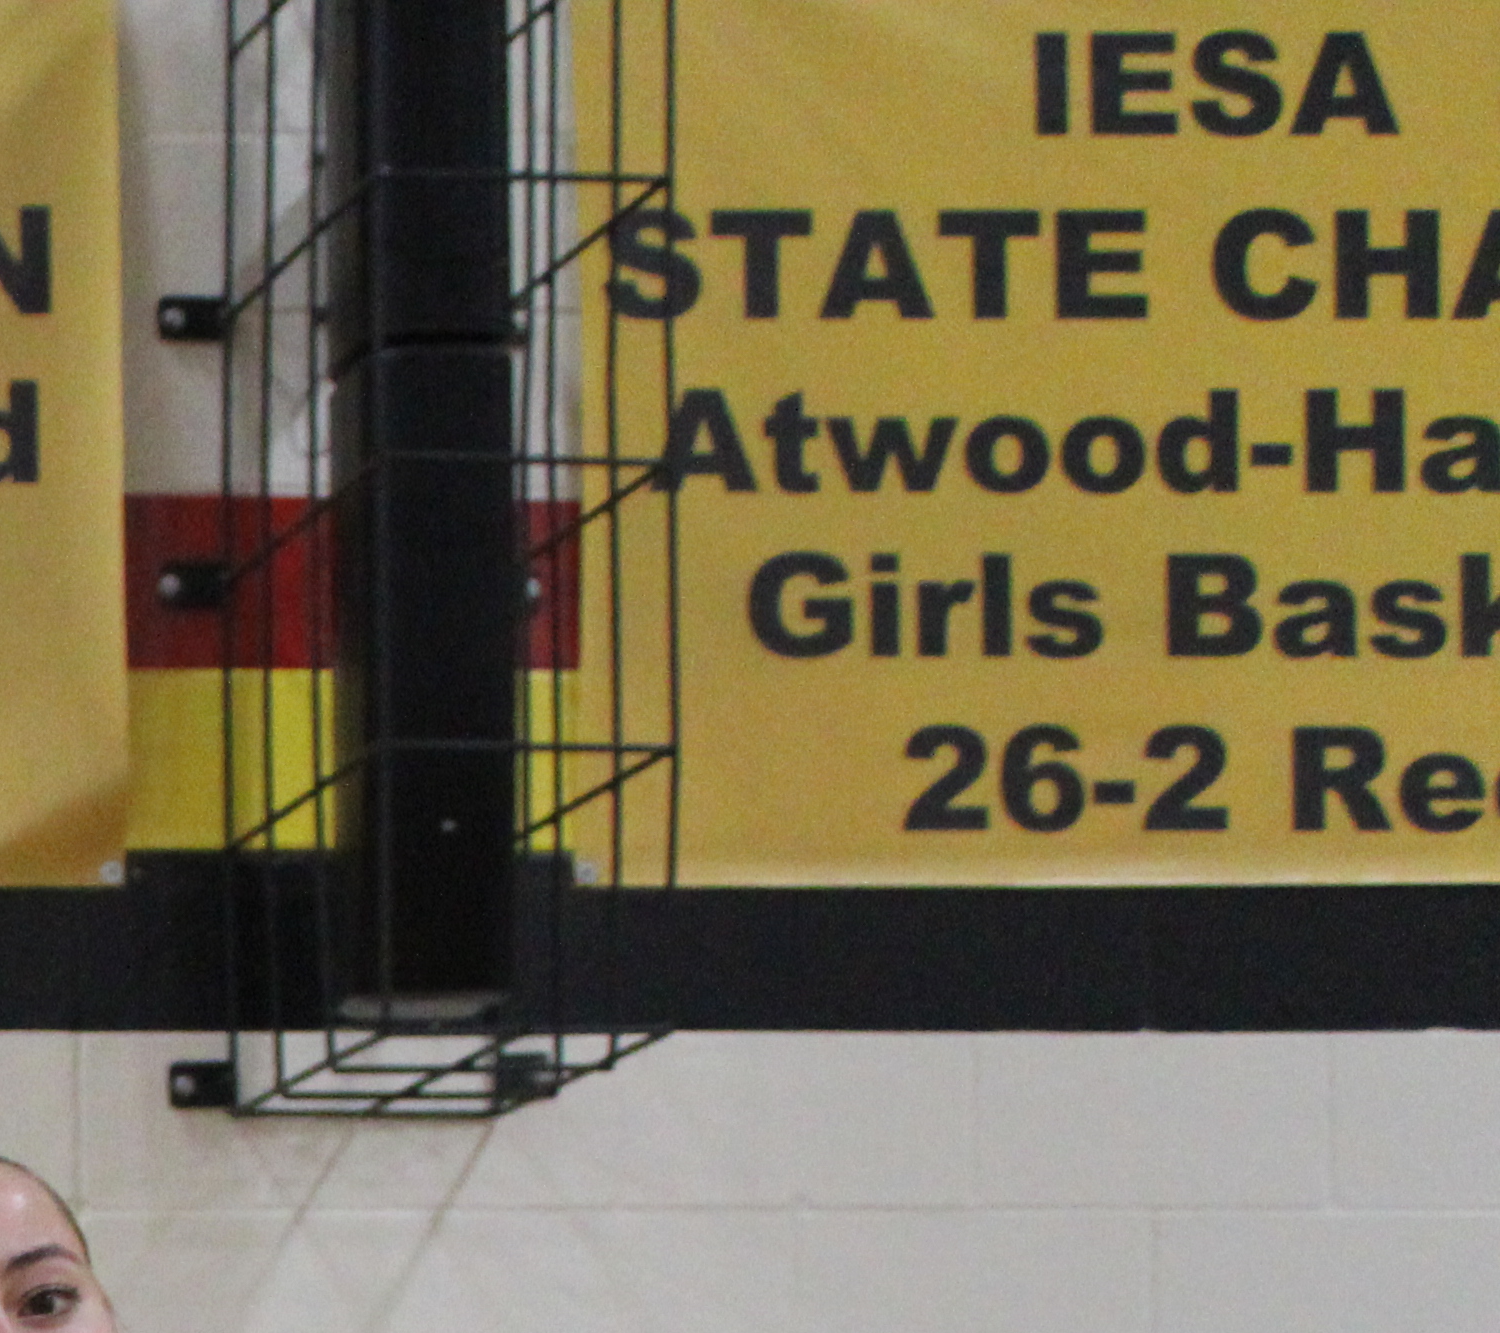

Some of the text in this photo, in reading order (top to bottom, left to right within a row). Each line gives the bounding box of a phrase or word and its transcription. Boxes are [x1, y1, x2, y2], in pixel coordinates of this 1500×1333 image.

[1034, 30, 1400, 137] IESA
[606, 208, 1149, 319] STATE
[748, 550, 1105, 659] Girls
[904, 723, 1500, 833] 26-2 Re
